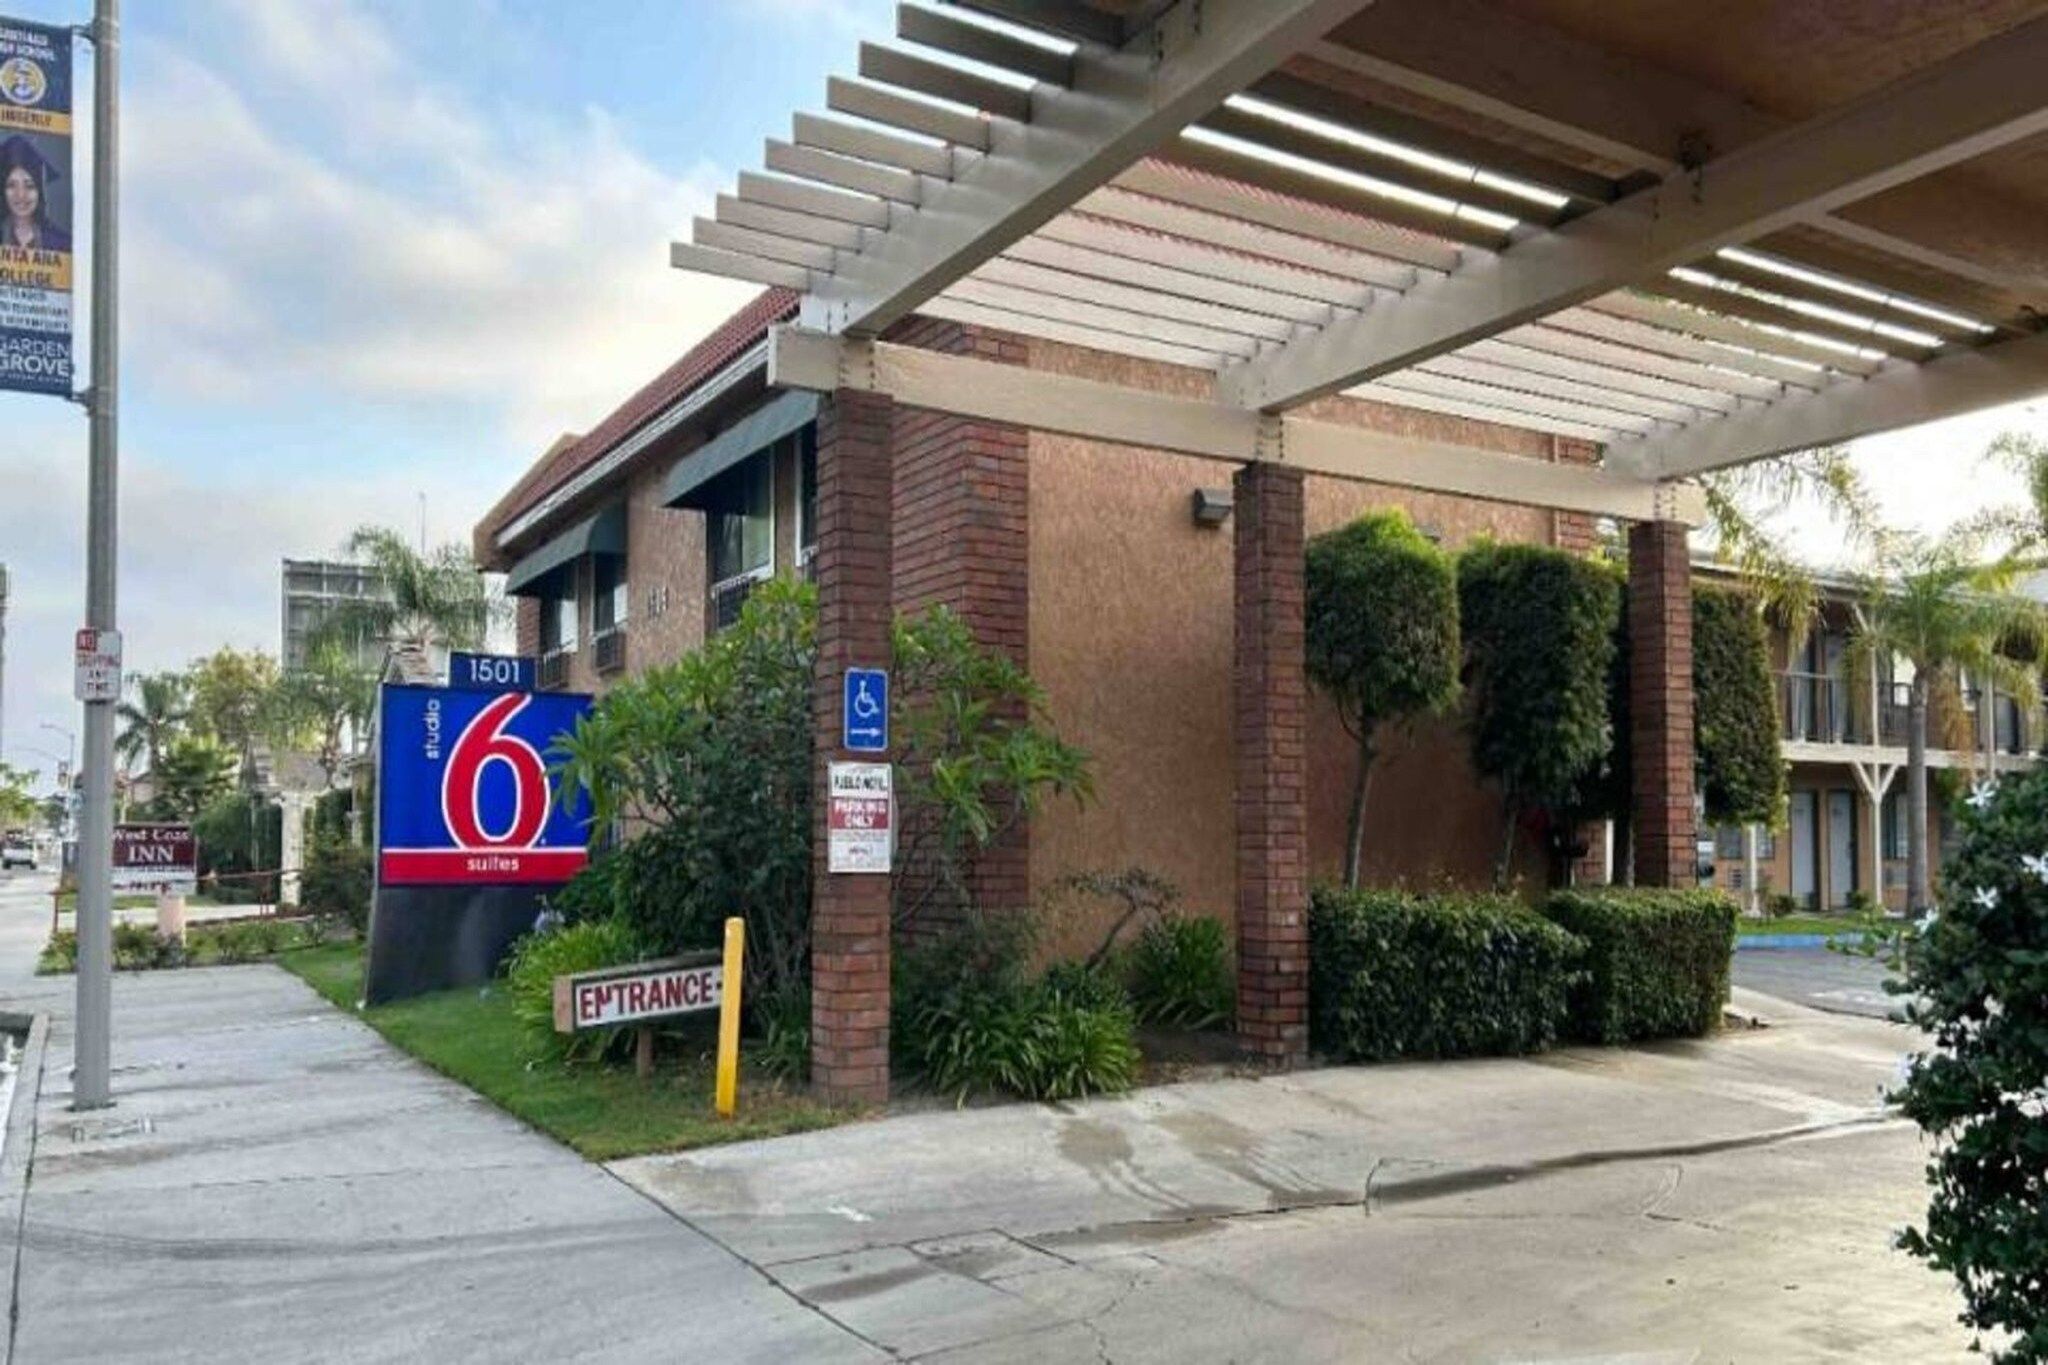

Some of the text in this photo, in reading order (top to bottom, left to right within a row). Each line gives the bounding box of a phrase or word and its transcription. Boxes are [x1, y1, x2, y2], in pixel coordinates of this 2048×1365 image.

[470, 658, 520, 684] 1501
[422, 698, 441, 760] studio
[442, 691, 551, 850] 6
[128, 845, 174, 863] INN
[467, 856, 520, 871] suites
[579, 971, 714, 1021] ENTRANCE
